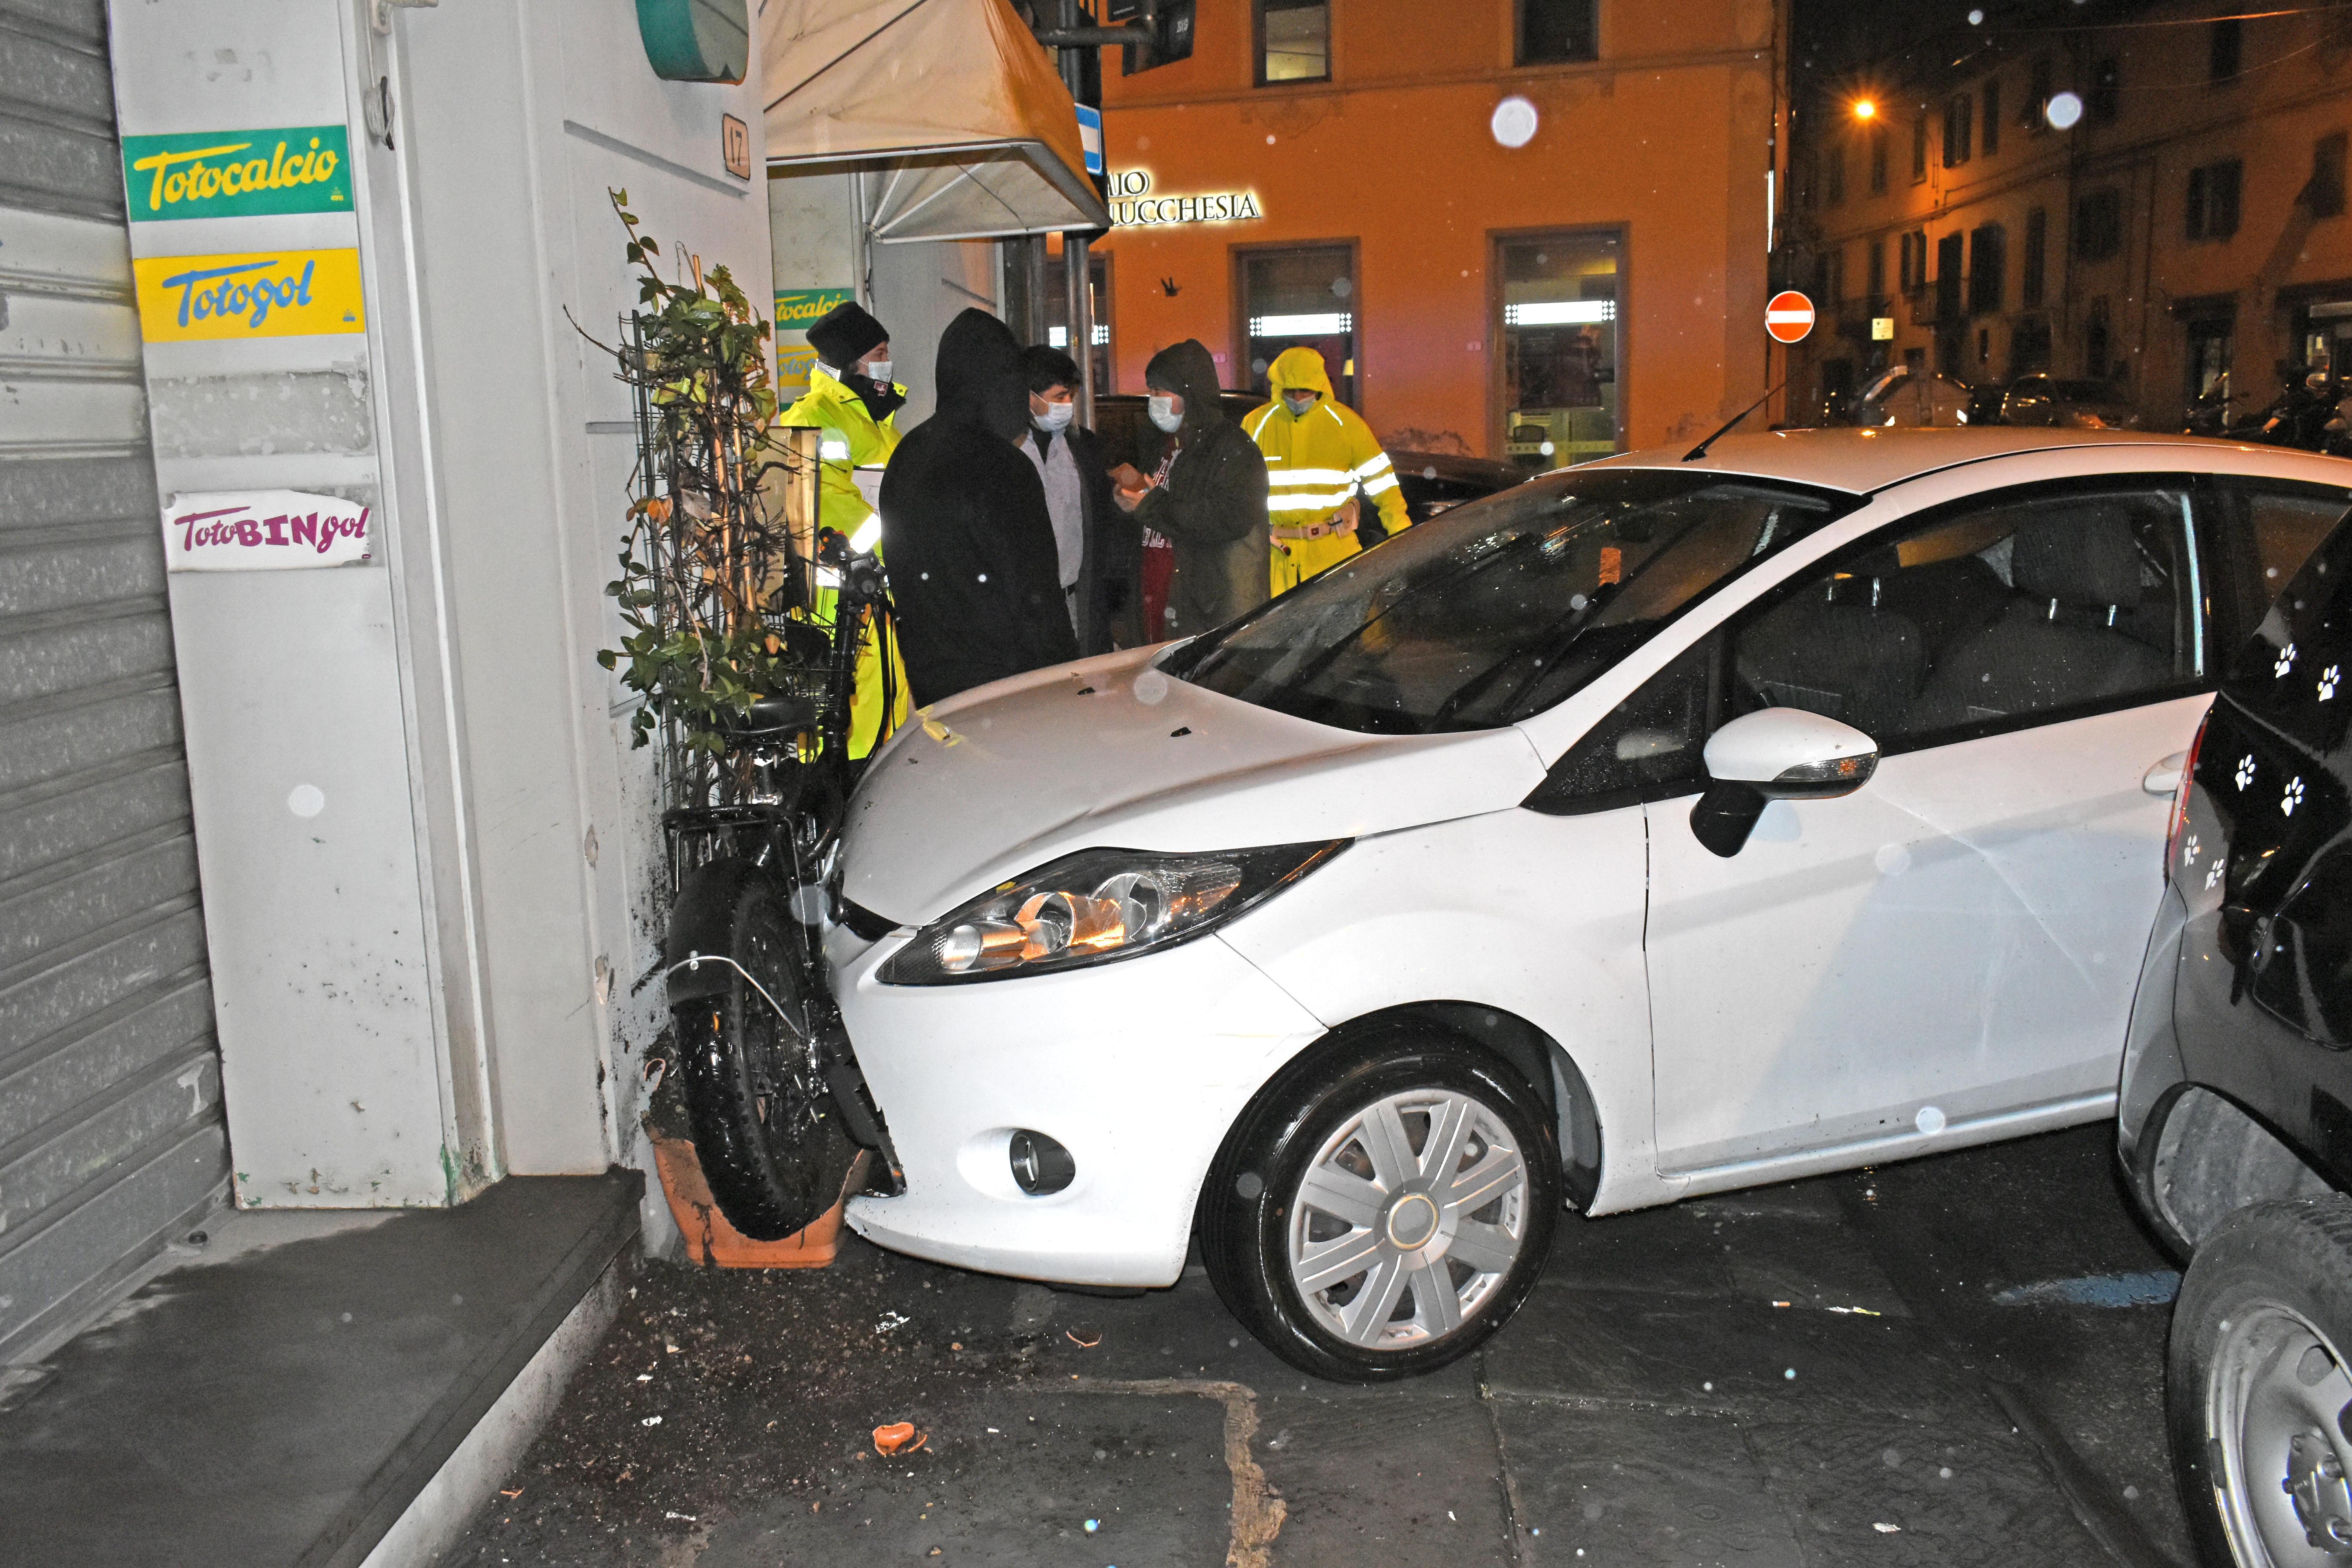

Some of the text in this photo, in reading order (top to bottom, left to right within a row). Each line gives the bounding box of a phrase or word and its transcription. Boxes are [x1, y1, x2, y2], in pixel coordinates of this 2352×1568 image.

[730, 126, 742, 166] 17
[134, 137, 339, 211] Totocalcio
[162, 260, 315, 328] Totogol
[775, 293, 849, 322] tocalci
[174, 506, 369, 554] TotoBINgol
